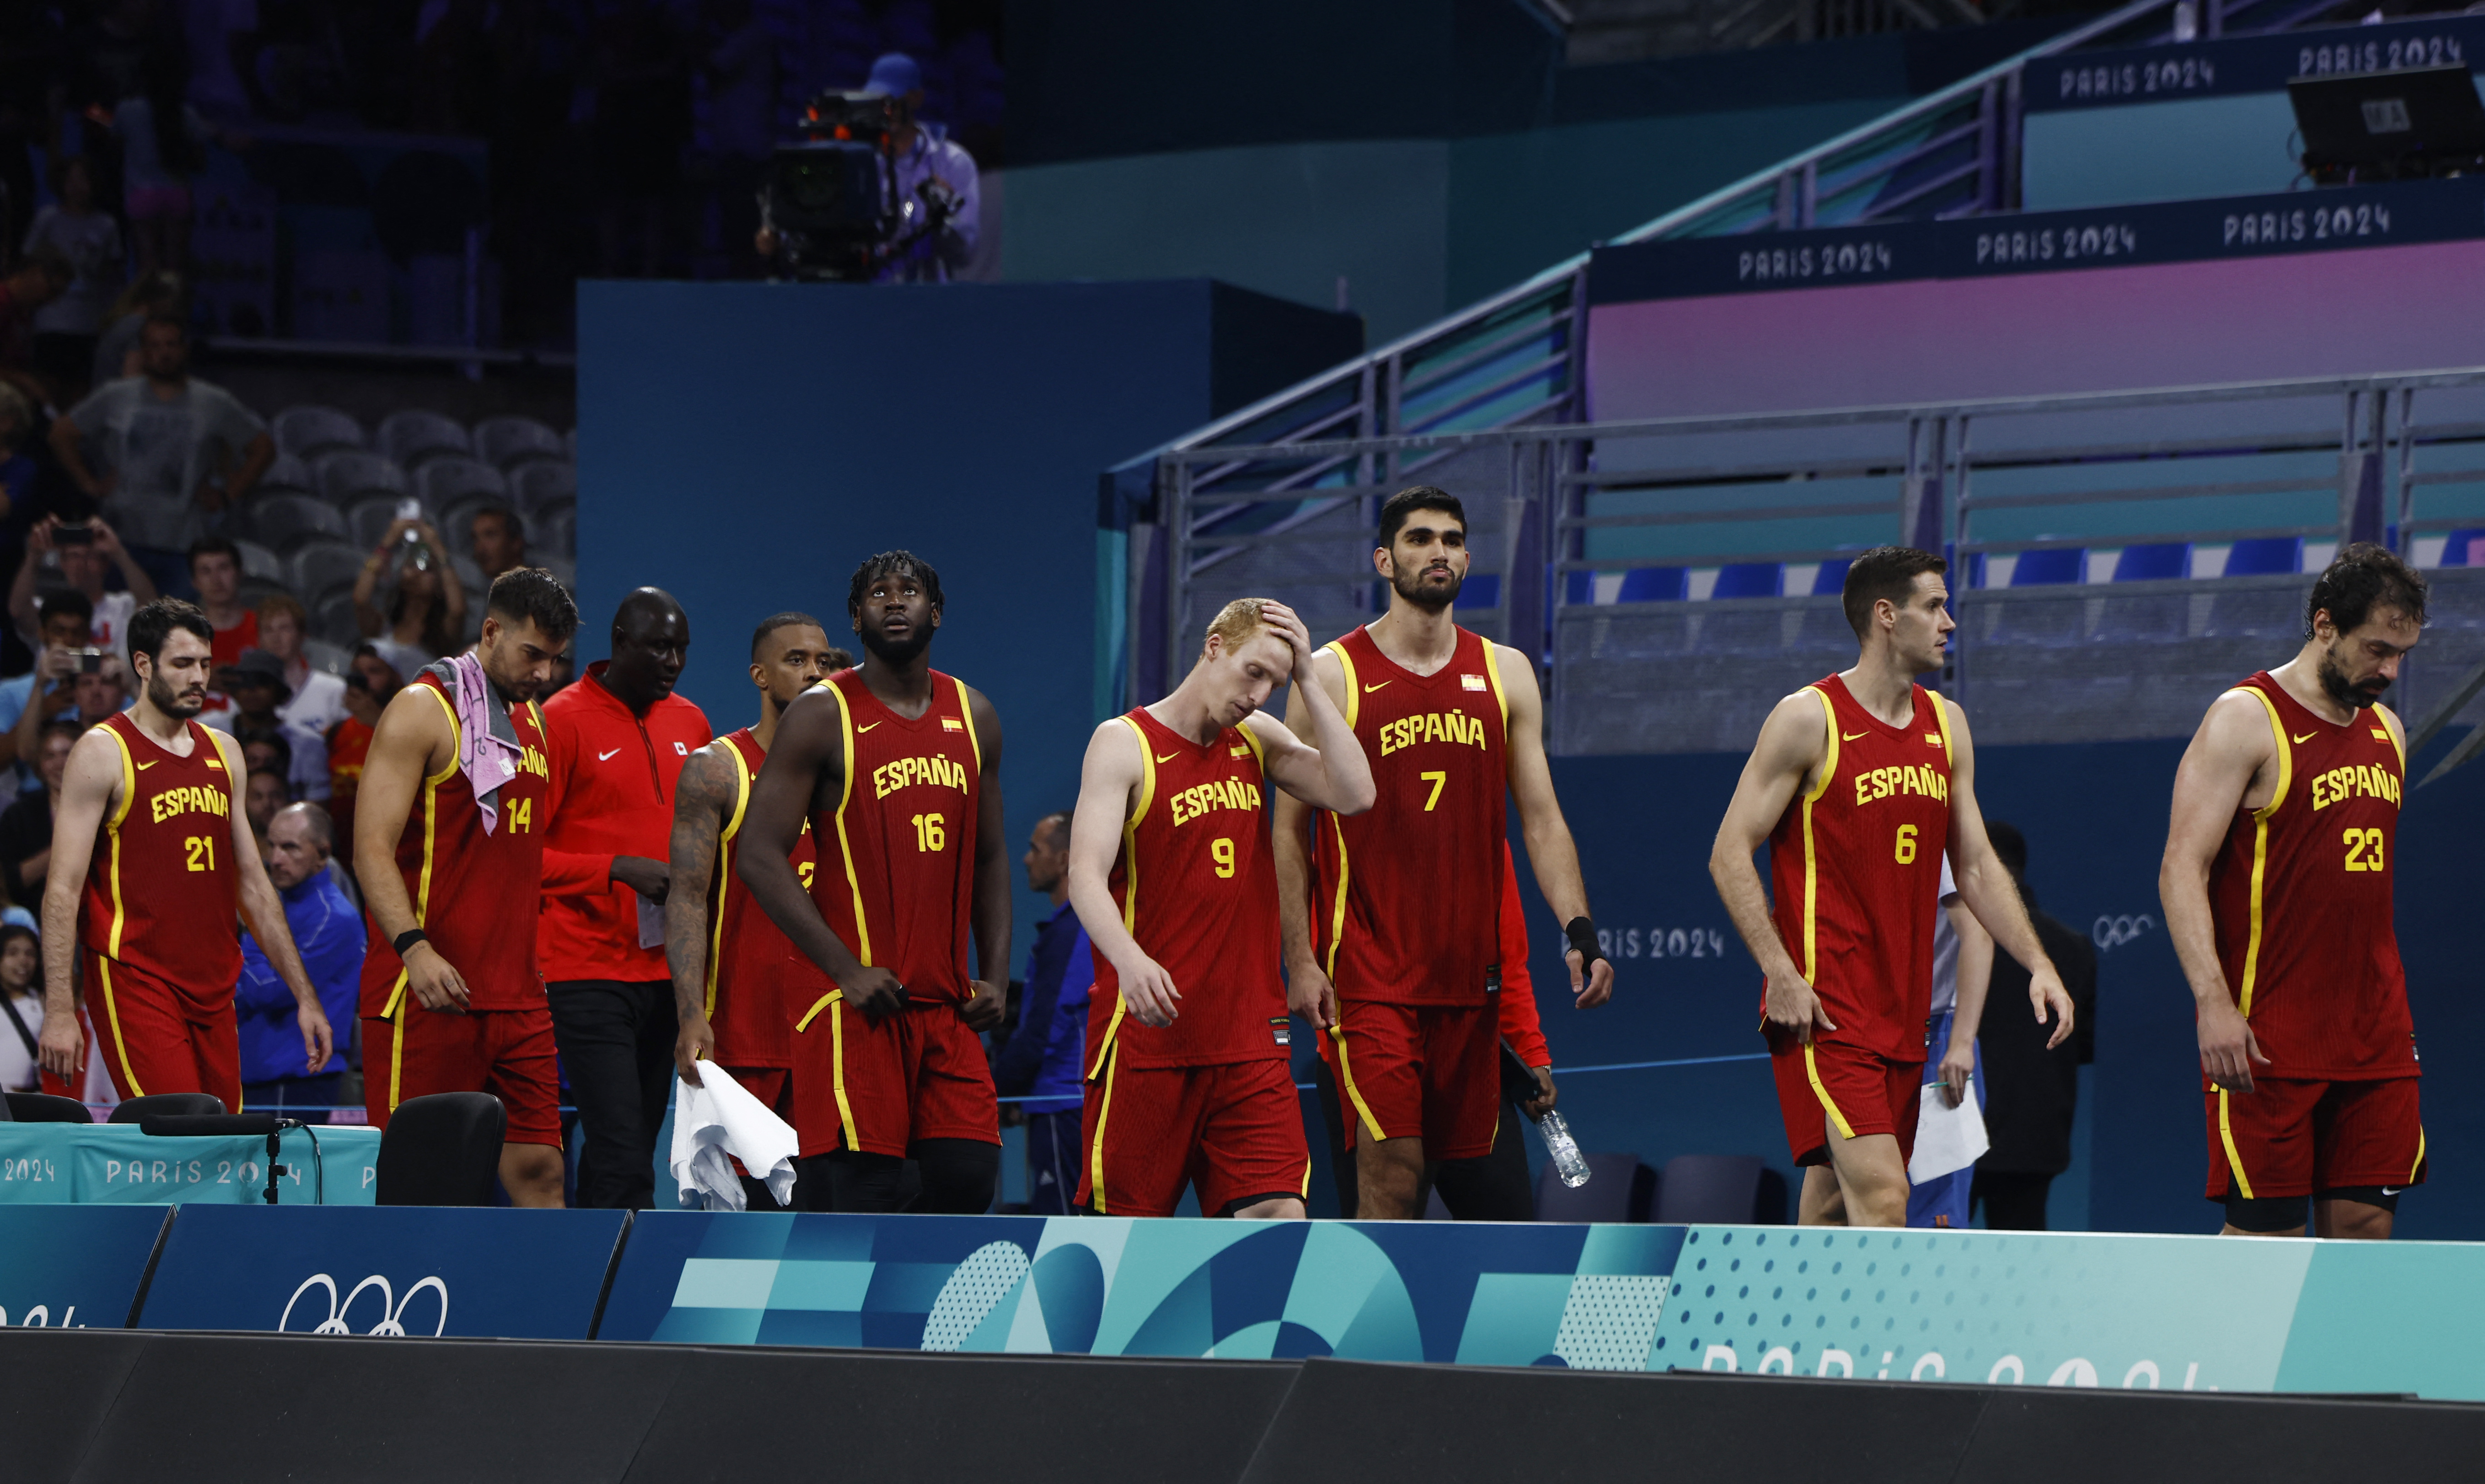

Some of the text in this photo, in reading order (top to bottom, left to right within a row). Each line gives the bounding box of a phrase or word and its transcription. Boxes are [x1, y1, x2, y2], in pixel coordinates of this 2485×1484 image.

[2388, 34, 2462, 69] 2024
[2144, 57, 2216, 93] 2024
[2062, 223, 2136, 259] 2024
[2313, 202, 2390, 240] 2024
[1821, 241, 1893, 276] 2024
[1379, 709, 1486, 757] ESPAÑA
[517, 744, 549, 783] AÑA
[872, 753, 968, 801] ESPAÑA
[150, 783, 229, 824] ESPAÑA
[1169, 775, 1262, 828] ESPAÑA
[1420, 771, 1447, 812] 7
[1854, 762, 1948, 808] ESPAÑA
[2312, 762, 2401, 812] ESPAÑA
[506, 797, 532, 834] 14
[911, 813, 945, 853] 16
[184, 835, 215, 872] 21
[1210, 837, 1235, 879] 9
[1894, 823, 1918, 865] 6
[2342, 827, 2384, 872] 23
[1649, 927, 1724, 959] 2024
[4, 1158, 55, 1182] 2024
